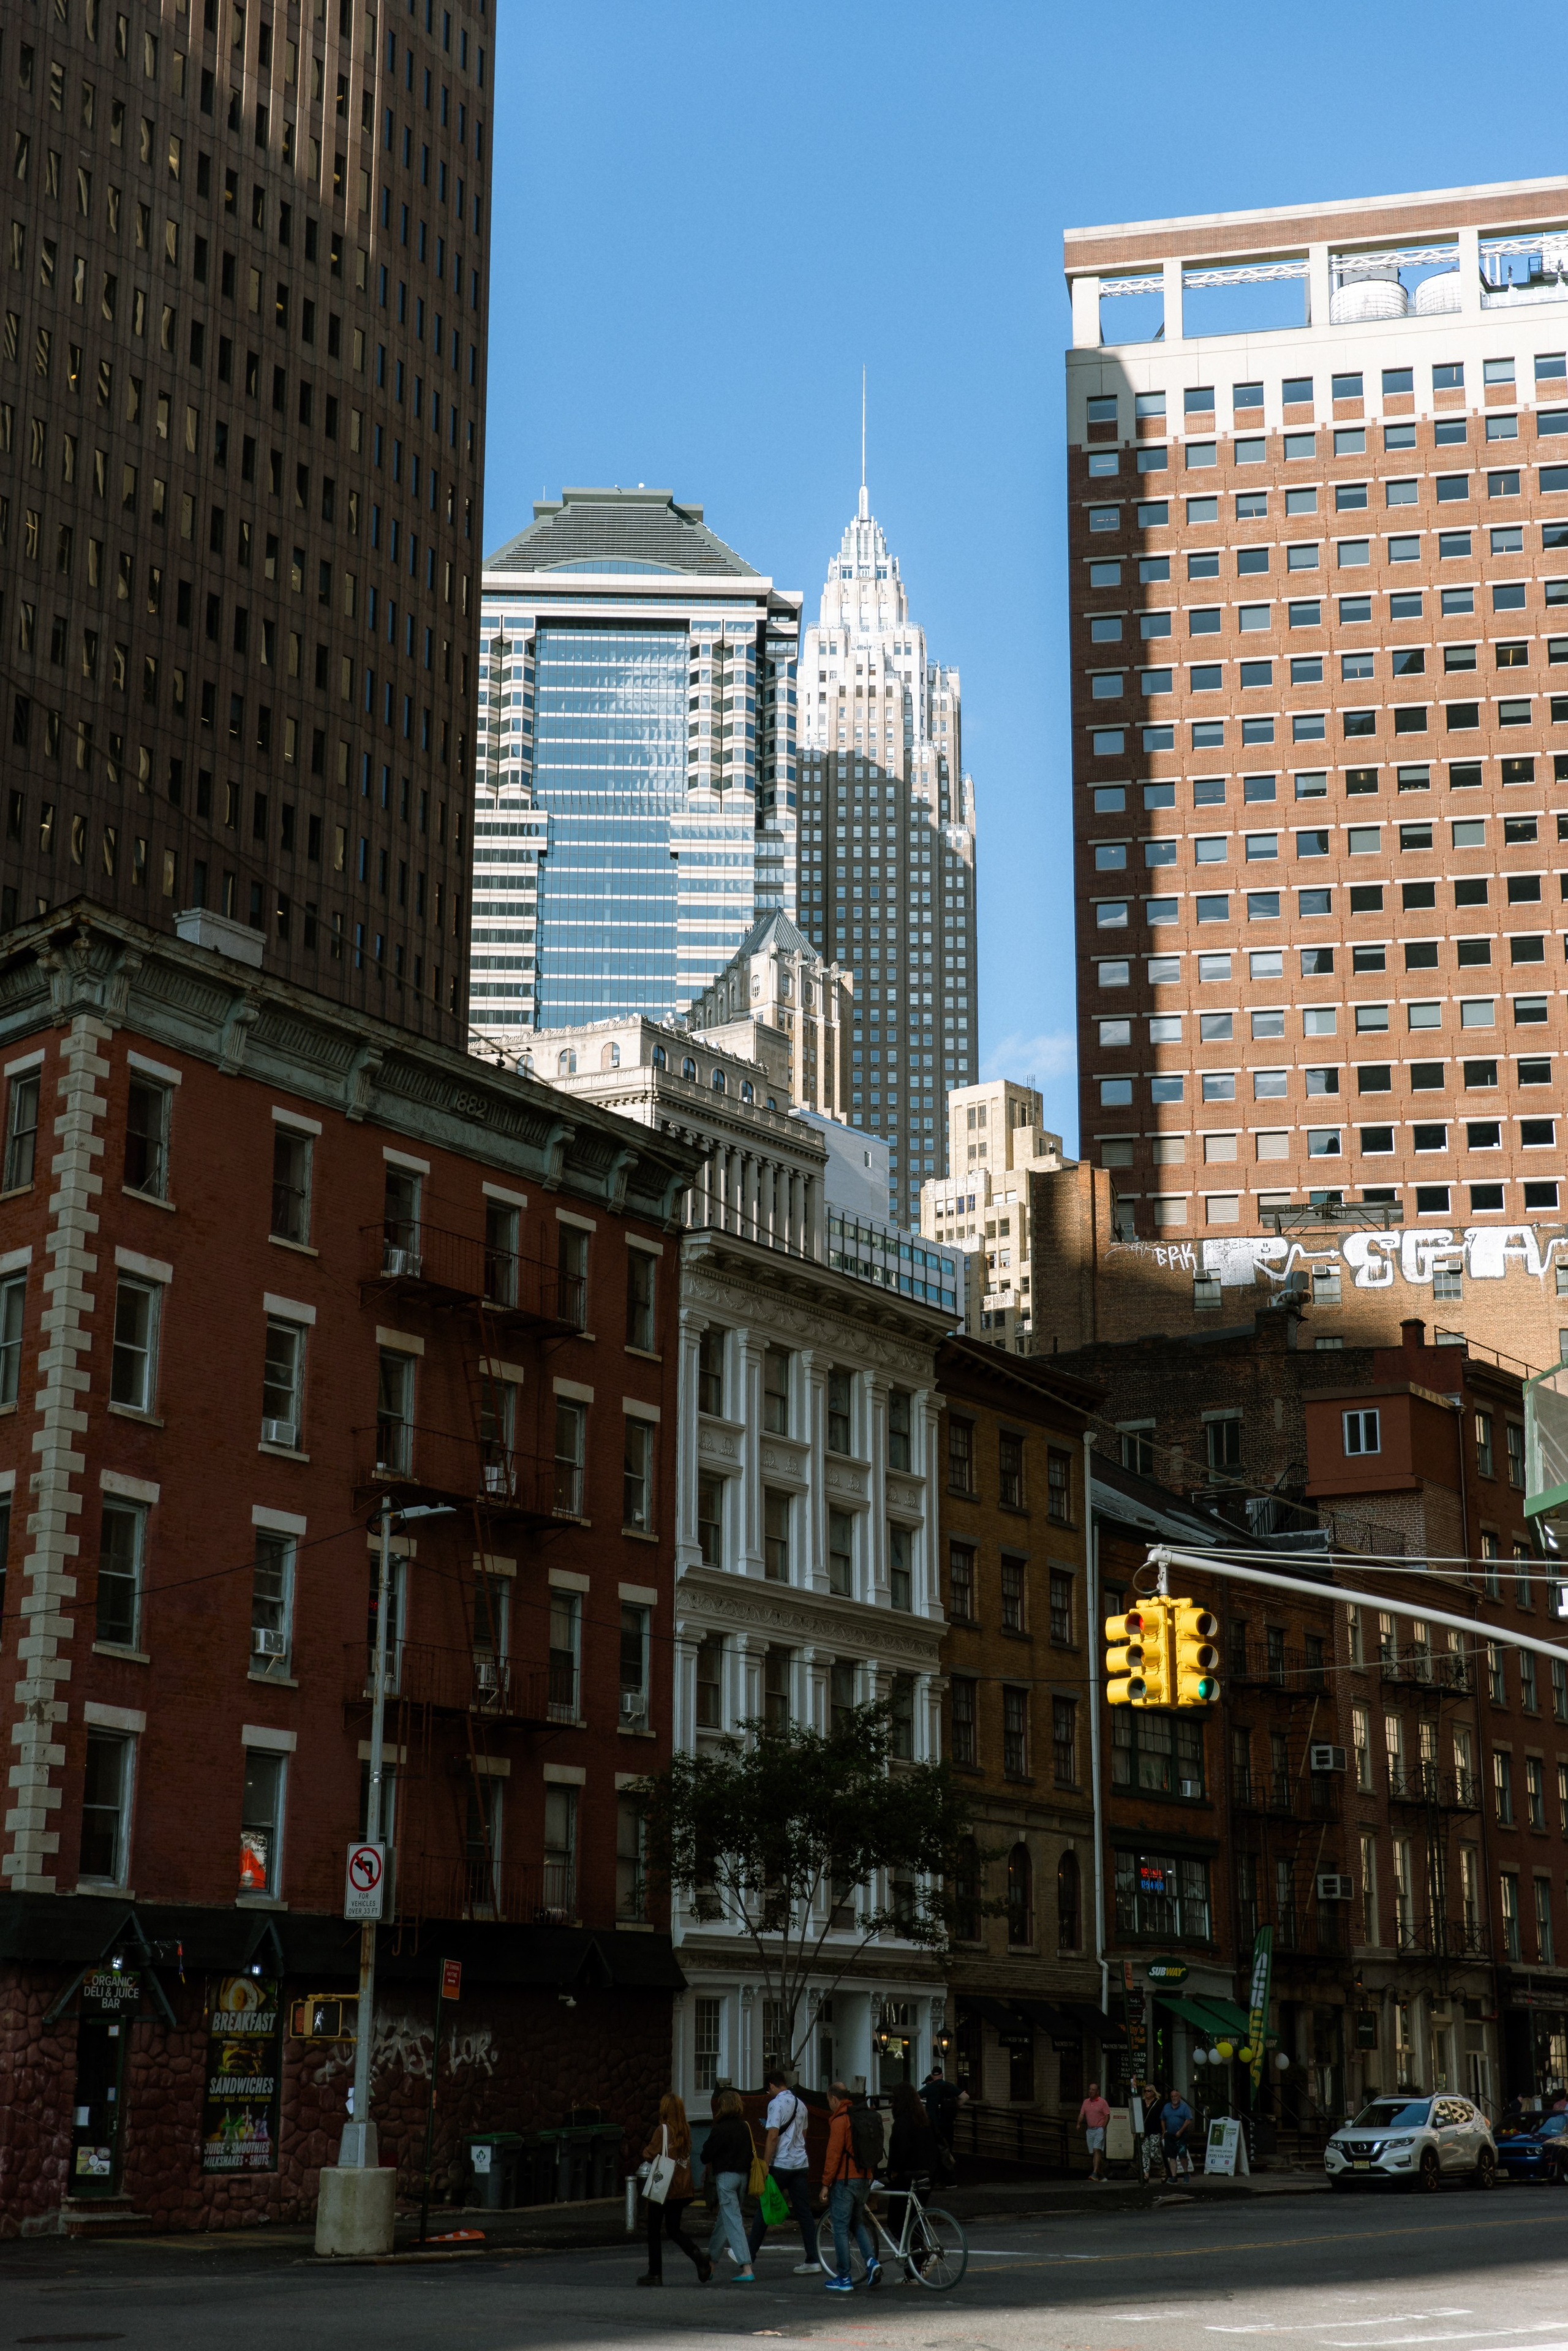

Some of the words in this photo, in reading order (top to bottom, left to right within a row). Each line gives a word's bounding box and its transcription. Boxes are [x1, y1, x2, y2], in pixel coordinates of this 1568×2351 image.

[1154, 1243, 1197, 1271] BRK
[1148, 1966, 1186, 1977] SUBWAY
[92, 1975, 133, 1987] ORGANIC
[84, 1986, 104, 1996] DELI
[105, 1987, 111, 1997] &
[113, 1987, 139, 1998] JUICE
[102, 1998, 120, 2009] BAR
[212, 2012, 276, 2031] BREAKFAST
[209, 2077, 274, 2094] SANDWICHES
[204, 2143, 225, 2154] JUICE
[231, 2142, 270, 2154] SMOOTHIES
[203, 2155, 244, 2167] MILKSHAKES
[249, 2154, 269, 2165] SHOTS
